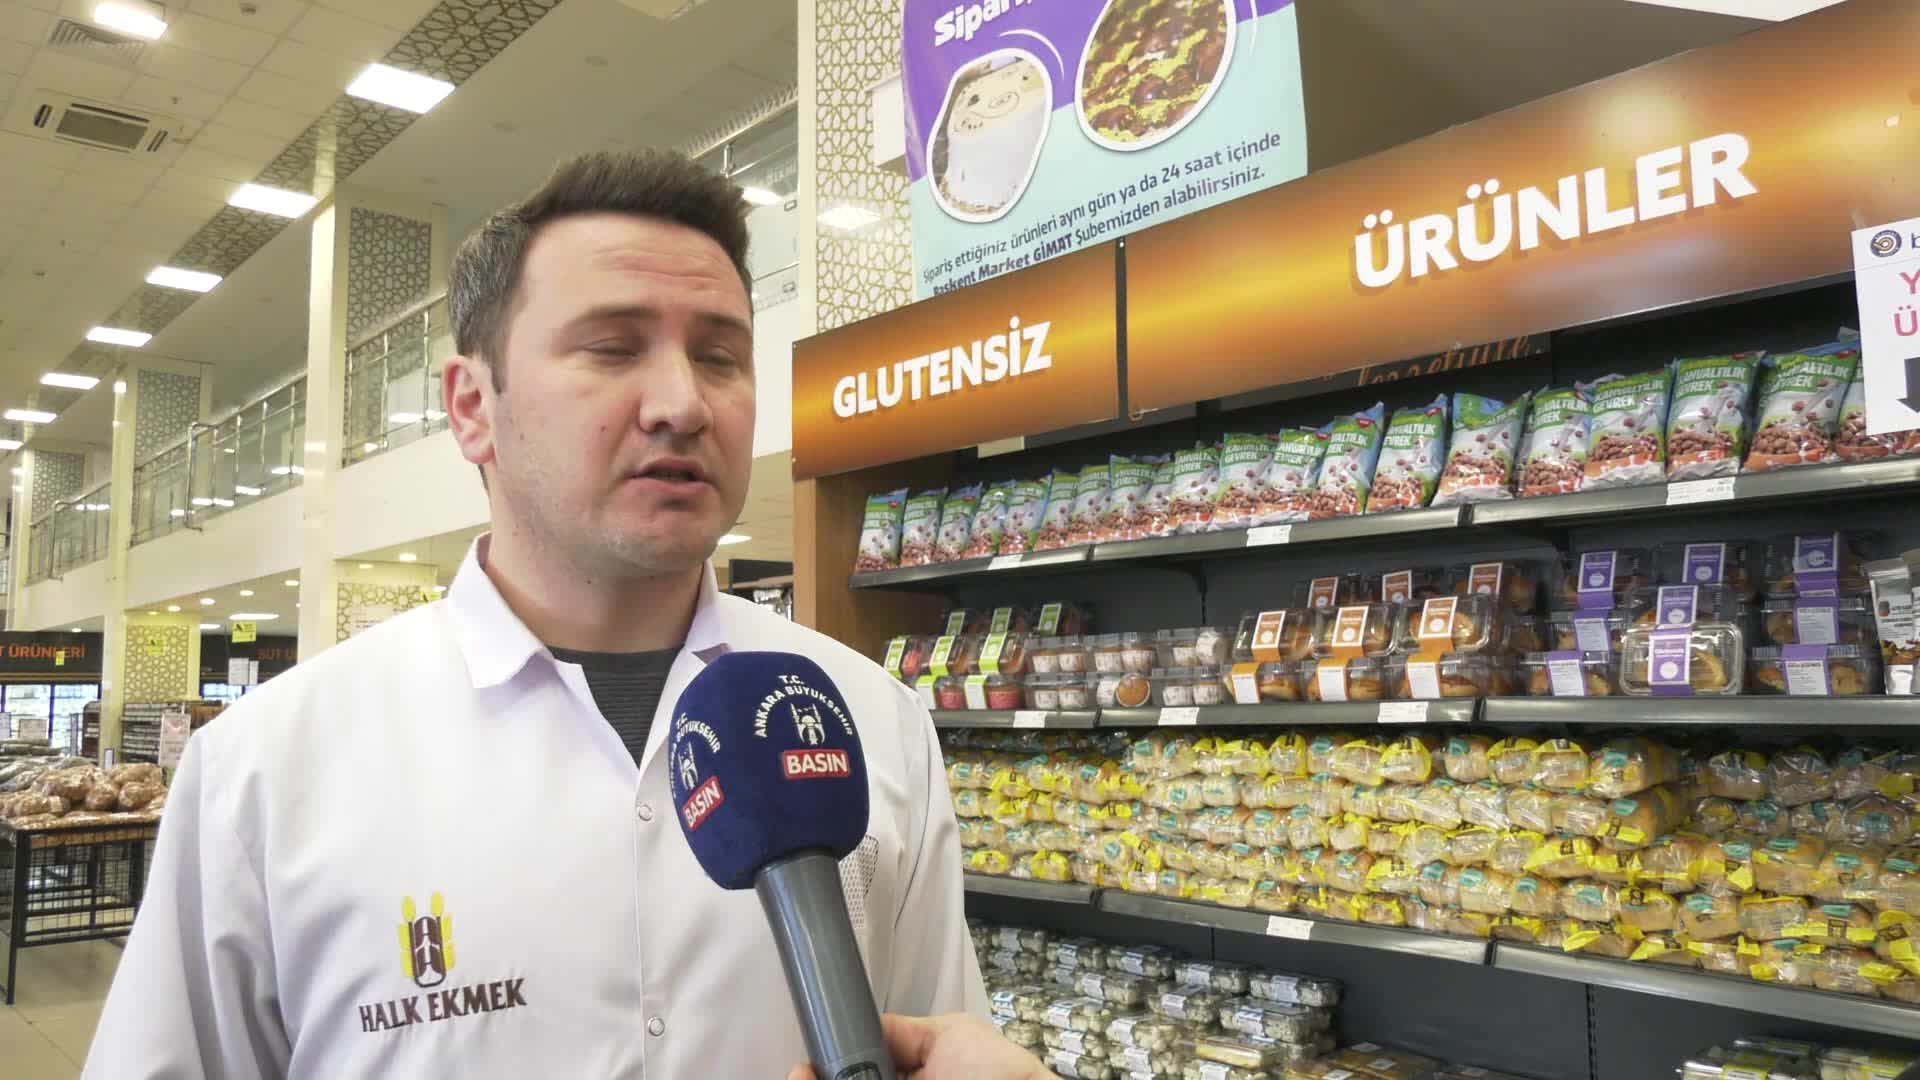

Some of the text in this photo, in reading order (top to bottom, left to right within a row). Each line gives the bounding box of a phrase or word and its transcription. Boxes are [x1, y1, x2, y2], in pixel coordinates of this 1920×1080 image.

[955, 239, 1007, 267] ettiğiniz
[1010, 215, 1057, 249] ürünleri
[1059, 205, 1085, 232] aynı
[1088, 192, 1117, 217] gün
[1119, 183, 1136, 205] ya
[1140, 173, 1157, 193] da
[1162, 164, 1180, 184] 24
[1185, 150, 1222, 175] saat
[1227, 133, 1281, 163] içinde
[978, 253, 1030, 281] Market
[1033, 233, 1073, 262] GİMAT
[1075, 200, 1160, 246] Şubemizden
[1164, 165, 1266, 209] alabilirsiniz.
[1354, 132, 1758, 289] ÜRÜNLER
[833, 316, 1052, 418] GLUTENSİZ
[754, 689, 786, 738] ANKARA
[786, 752, 848, 774] BASIN
[684, 780, 721, 829] BASIN
[358, 978, 528, 1033] HALK EKMEK
